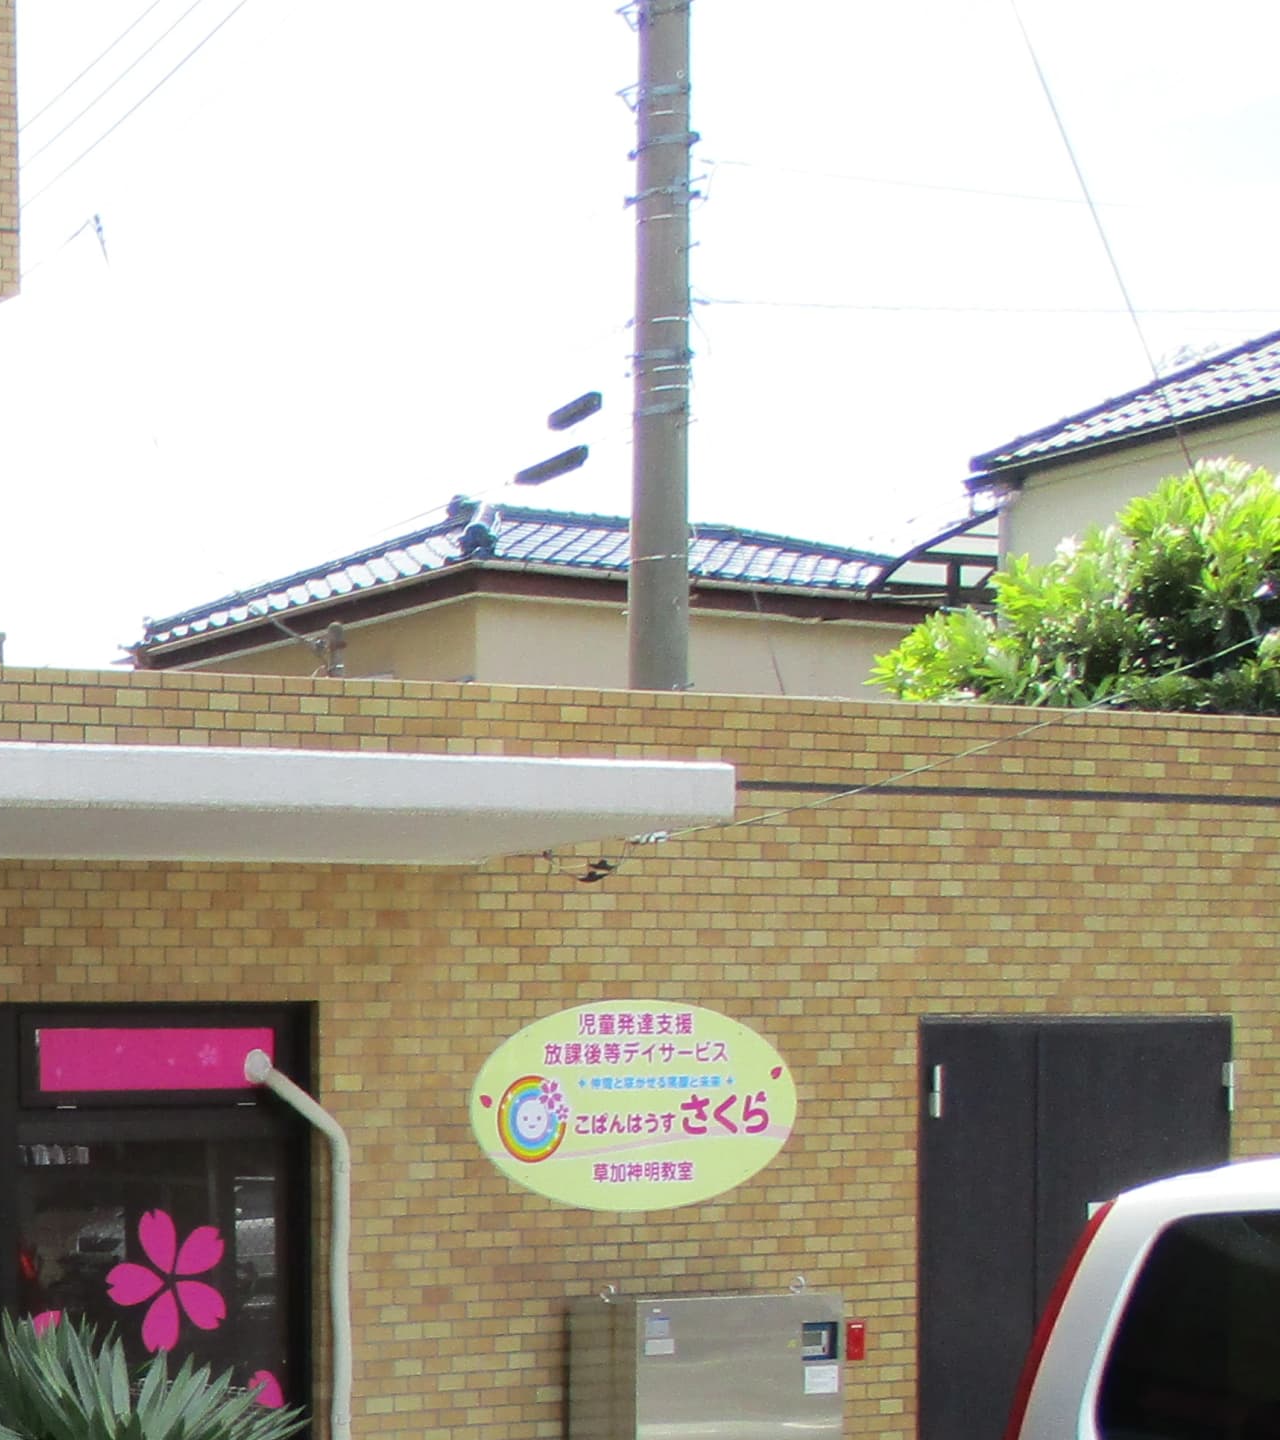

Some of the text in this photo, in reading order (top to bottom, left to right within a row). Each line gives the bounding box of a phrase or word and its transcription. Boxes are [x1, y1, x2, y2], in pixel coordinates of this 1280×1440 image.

[578, 1012, 694, 1036] 児童発達支援
[543, 1041, 729, 1066] 放課後等デイサービス
[592, 1161, 694, 1183] 草加神明教室
